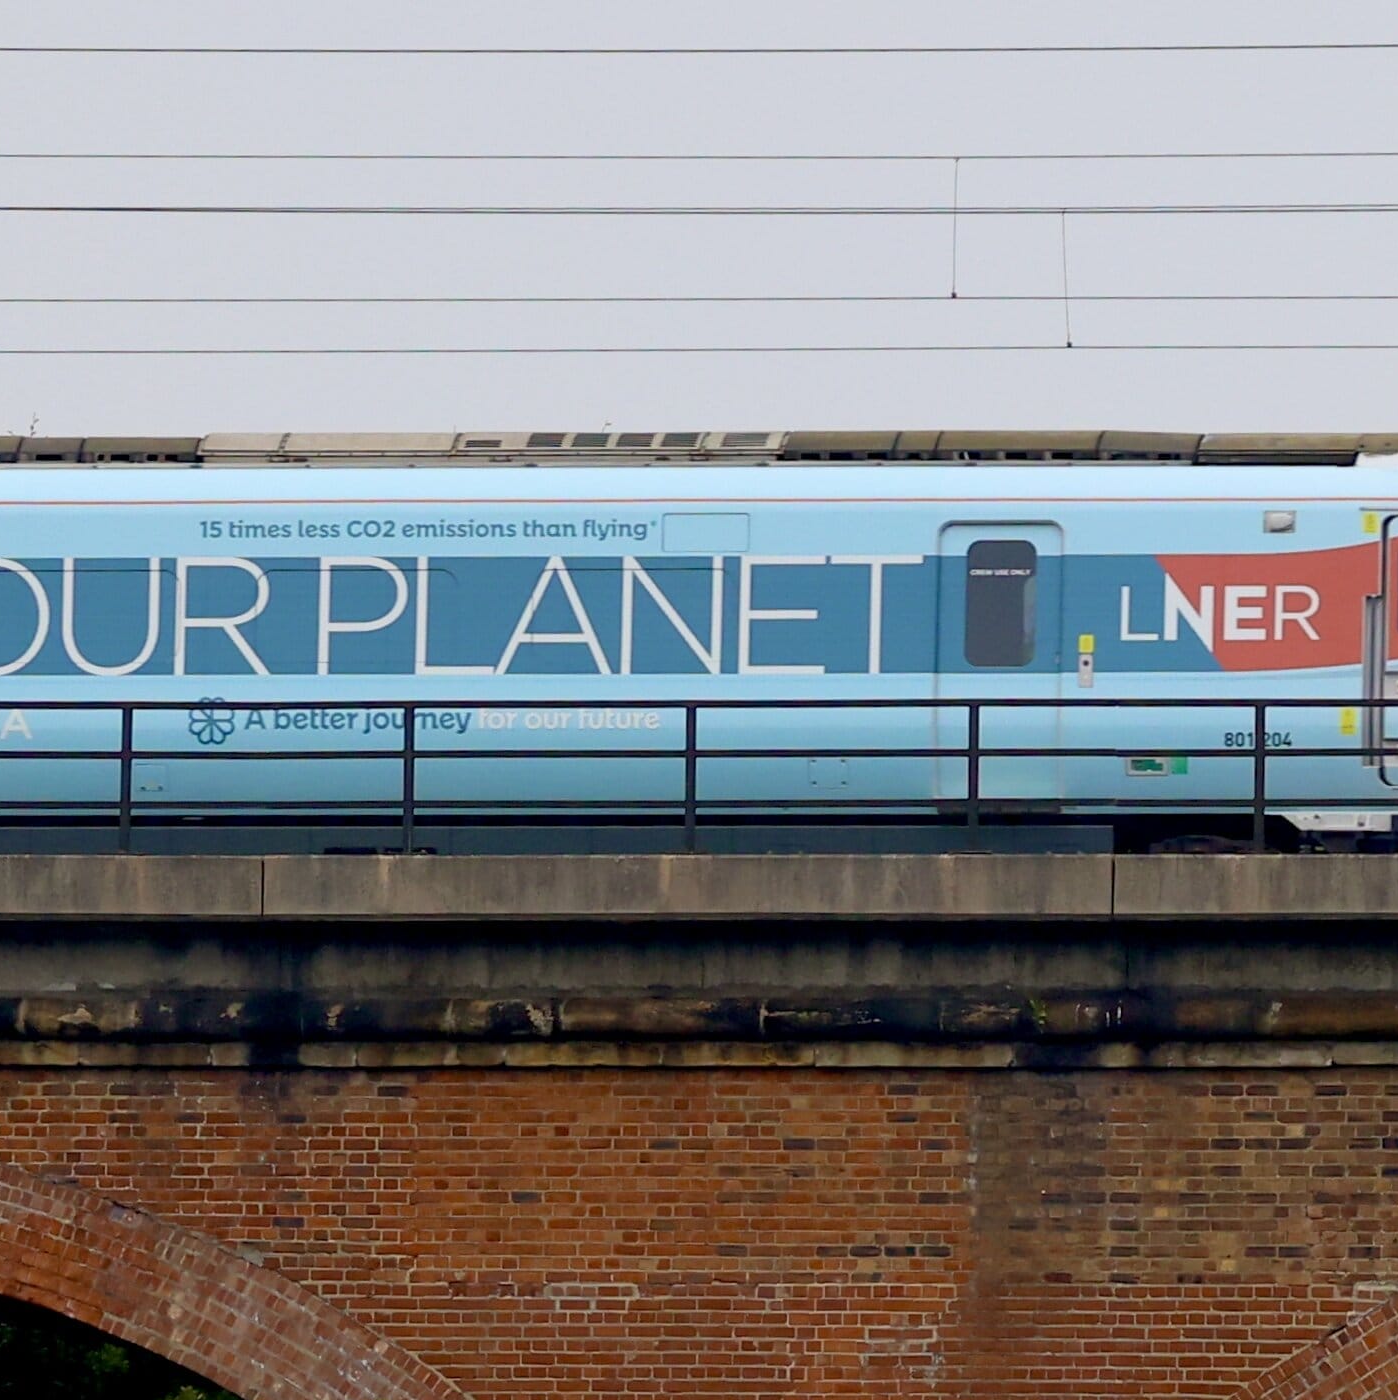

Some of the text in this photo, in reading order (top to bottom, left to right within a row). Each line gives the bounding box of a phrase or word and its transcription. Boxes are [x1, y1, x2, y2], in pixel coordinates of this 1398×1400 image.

[199, 520, 223, 539] 15
[229, 519, 292, 539] times
[298, 519, 340, 539] less
[347, 520, 396, 539] CO2
[402, 519, 517, 539] emissions
[523, 520, 578, 538] than
[317, 554, 925, 676] PLANET
[1120, 572, 1321, 653] LNER
[244, 708, 266, 730] A
[274, 707, 359, 730] better
[478, 707, 518, 730] for
[525, 710, 571, 730] our
[579, 707, 661, 730] future
[1224, 731, 1254, 748] 801
